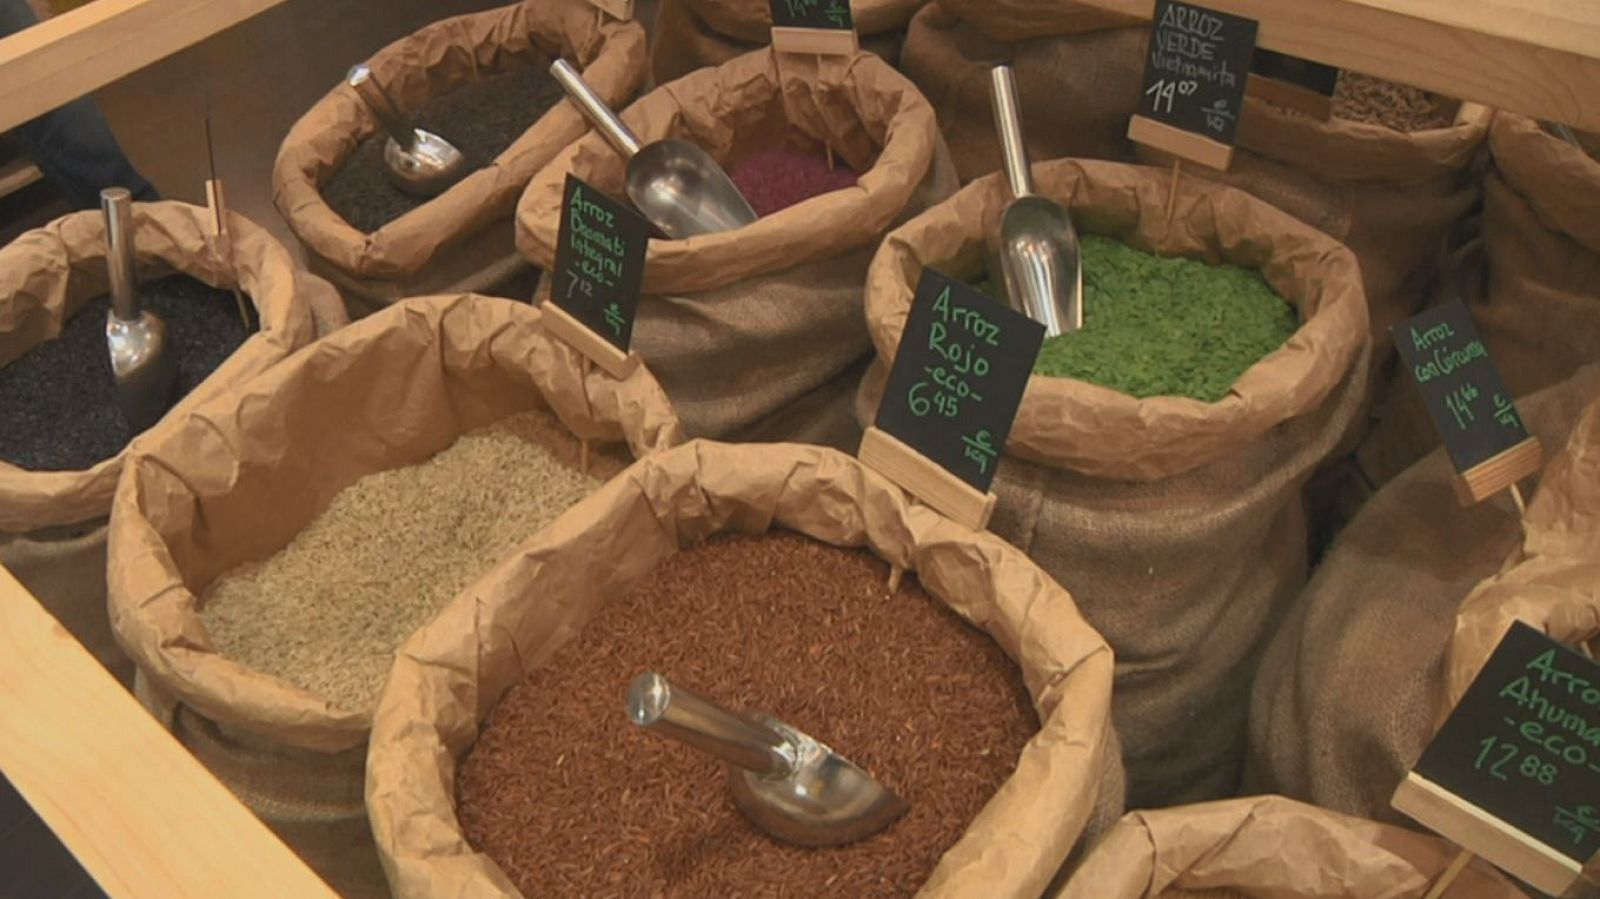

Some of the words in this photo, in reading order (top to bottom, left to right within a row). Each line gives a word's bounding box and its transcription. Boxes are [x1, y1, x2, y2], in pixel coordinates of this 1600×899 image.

[1159, 4, 1224, 41] ARROZ
[1156, 29, 1216, 61] VERDE
[570, 186, 615, 228] Arroz
[932, 286, 1001, 346] Arroz
[1410, 322, 1455, 352] Arroz
[929, 322, 989, 376] Rojo
[1415, 362, 1441, 383] con
[1526, 649, 1600, 710] Arro
[1499, 676, 1600, 747] Ahuma
